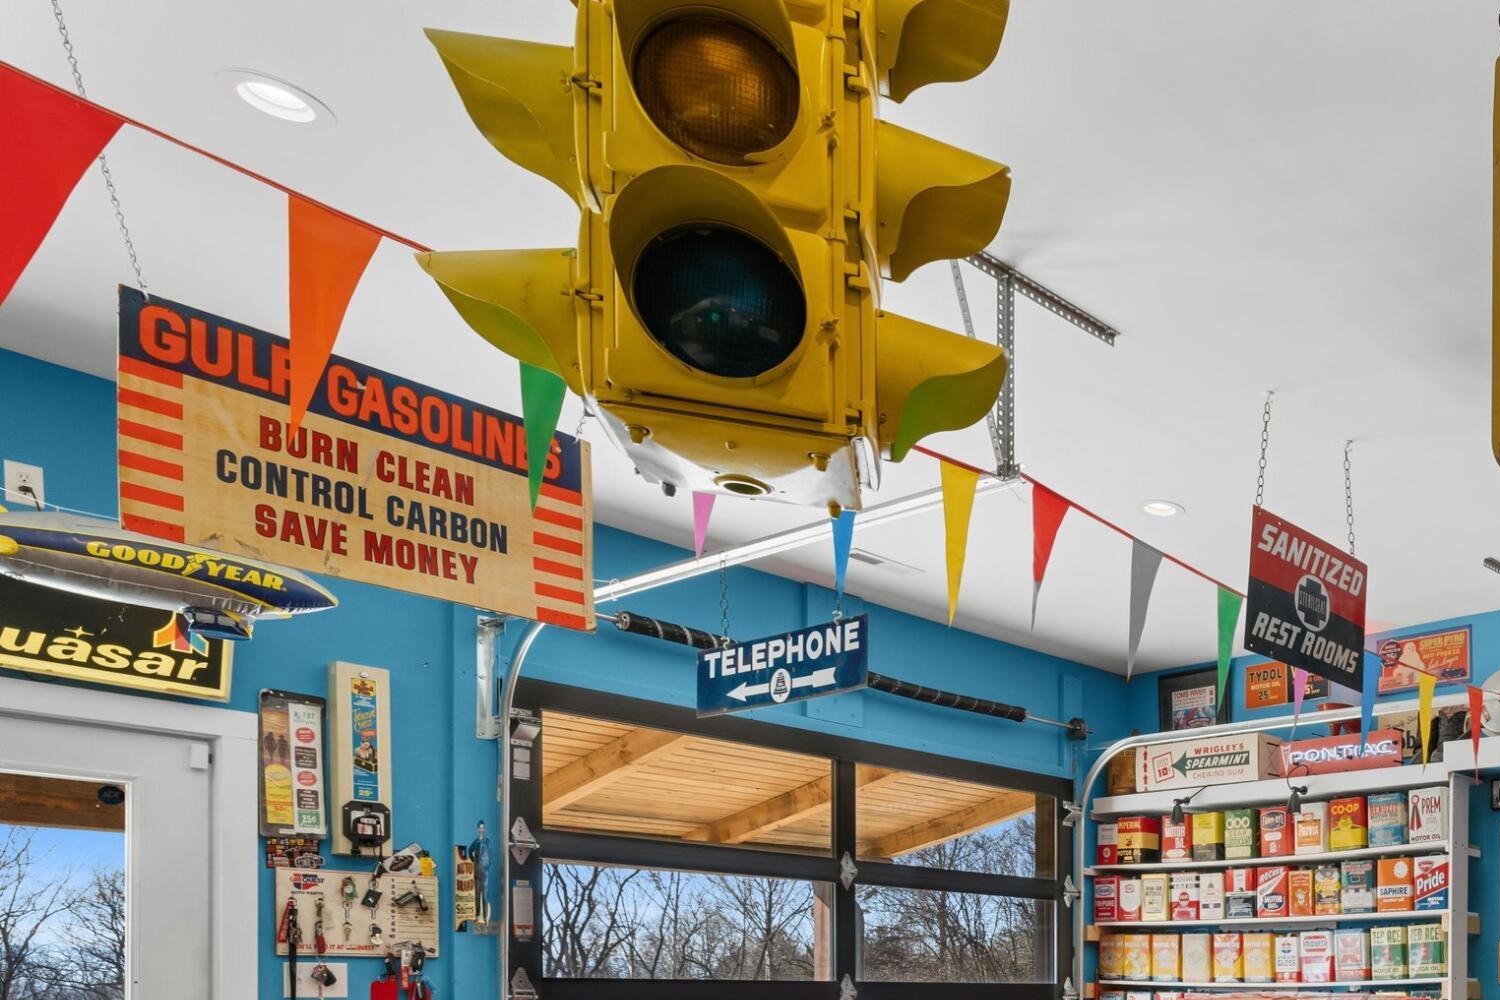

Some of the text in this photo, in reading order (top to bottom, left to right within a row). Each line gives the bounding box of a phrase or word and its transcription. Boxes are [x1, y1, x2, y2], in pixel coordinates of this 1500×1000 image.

[260, 415, 474, 506] BURN CLEAN
[216, 448, 508, 555] CONTROL CARBON
[253, 502, 480, 586] SAVE MONEY
[1257, 523, 1364, 597] SANITIZED
[703, 621, 860, 679] TELEPHONE
[1252, 610, 1302, 650] REST
[1301, 627, 1360, 675] ROOMS
[0, 627, 208, 681] uasar
[1249, 667, 1283, 683] TYDOL
[1250, 681, 1281, 691] MOTOR OIL
[1194, 742, 1245, 756] WRIGLEY'S
[1288, 739, 1396, 764] PONTIAC
[1185, 753, 1249, 770] SPEARMINT
[1192, 767, 1245, 780] CHEWING GUM
[1331, 803, 1360, 814] CO-OP
[1421, 797, 1441, 813] PREM
[1164, 826, 1186, 838] MOTOR
[1411, 834, 1431, 842] MOTOR
[1174, 837, 1185, 849] OIL
[1416, 869, 1446, 895] Pride
[1379, 886, 1409, 896] SAPHIRE
[1262, 895, 1283, 903] MOTOR
[1386, 928, 1401, 943] ACE
[1424, 926, 1440, 941] ACE
[1277, 959, 1297, 967] GLOSS
